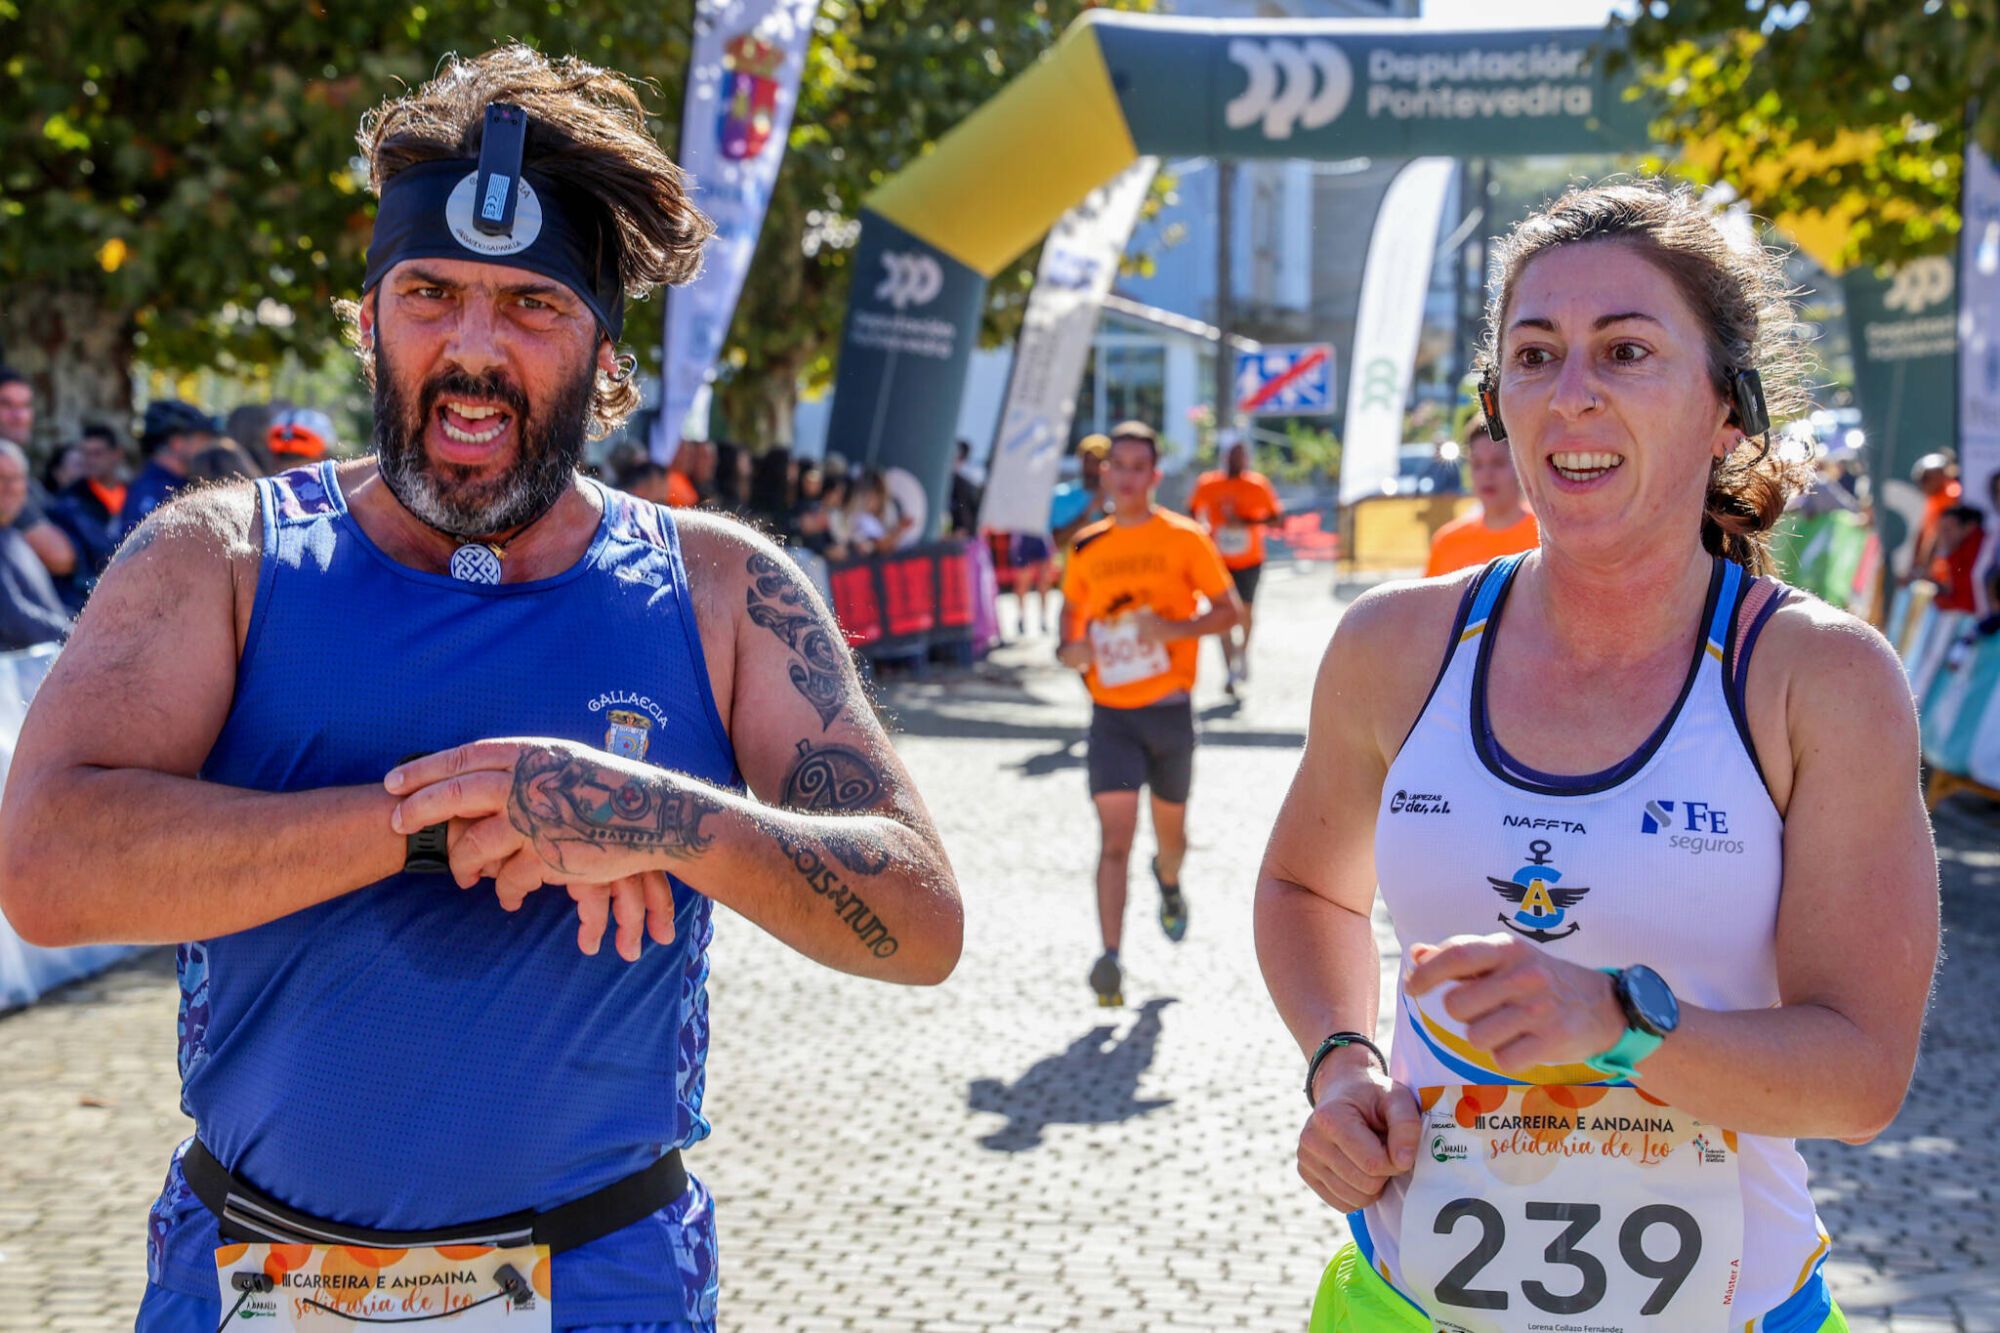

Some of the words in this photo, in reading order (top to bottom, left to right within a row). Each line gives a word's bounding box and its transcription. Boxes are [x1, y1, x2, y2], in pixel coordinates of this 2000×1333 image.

[1368, 43, 1592, 88] Deputación
[1367, 81, 1592, 119] Pontevedra
[588, 690, 668, 730] GALLAECIA
[1503, 815, 1586, 834] NAFFTA
[1669, 835, 1744, 855] seguros
[1489, 1115, 1570, 1130] CARREIRA
[1577, 1116, 1586, 1130] E
[1591, 1117, 1674, 1132] ANDAINA
[1490, 1129, 1595, 1159] solidaria
[1601, 1131, 1633, 1158] de
[1640, 1133, 1675, 1164] Leo
[1433, 1197, 1702, 1316] 239
[1730, 1259, 1740, 1268] A
[293, 1273, 370, 1288] CARREIRA
[376, 1275, 386, 1288] E
[391, 1270, 477, 1288] ANDAINA
[401, 1286, 433, 1315] de
[1528, 1323, 1553, 1331] Lorena
